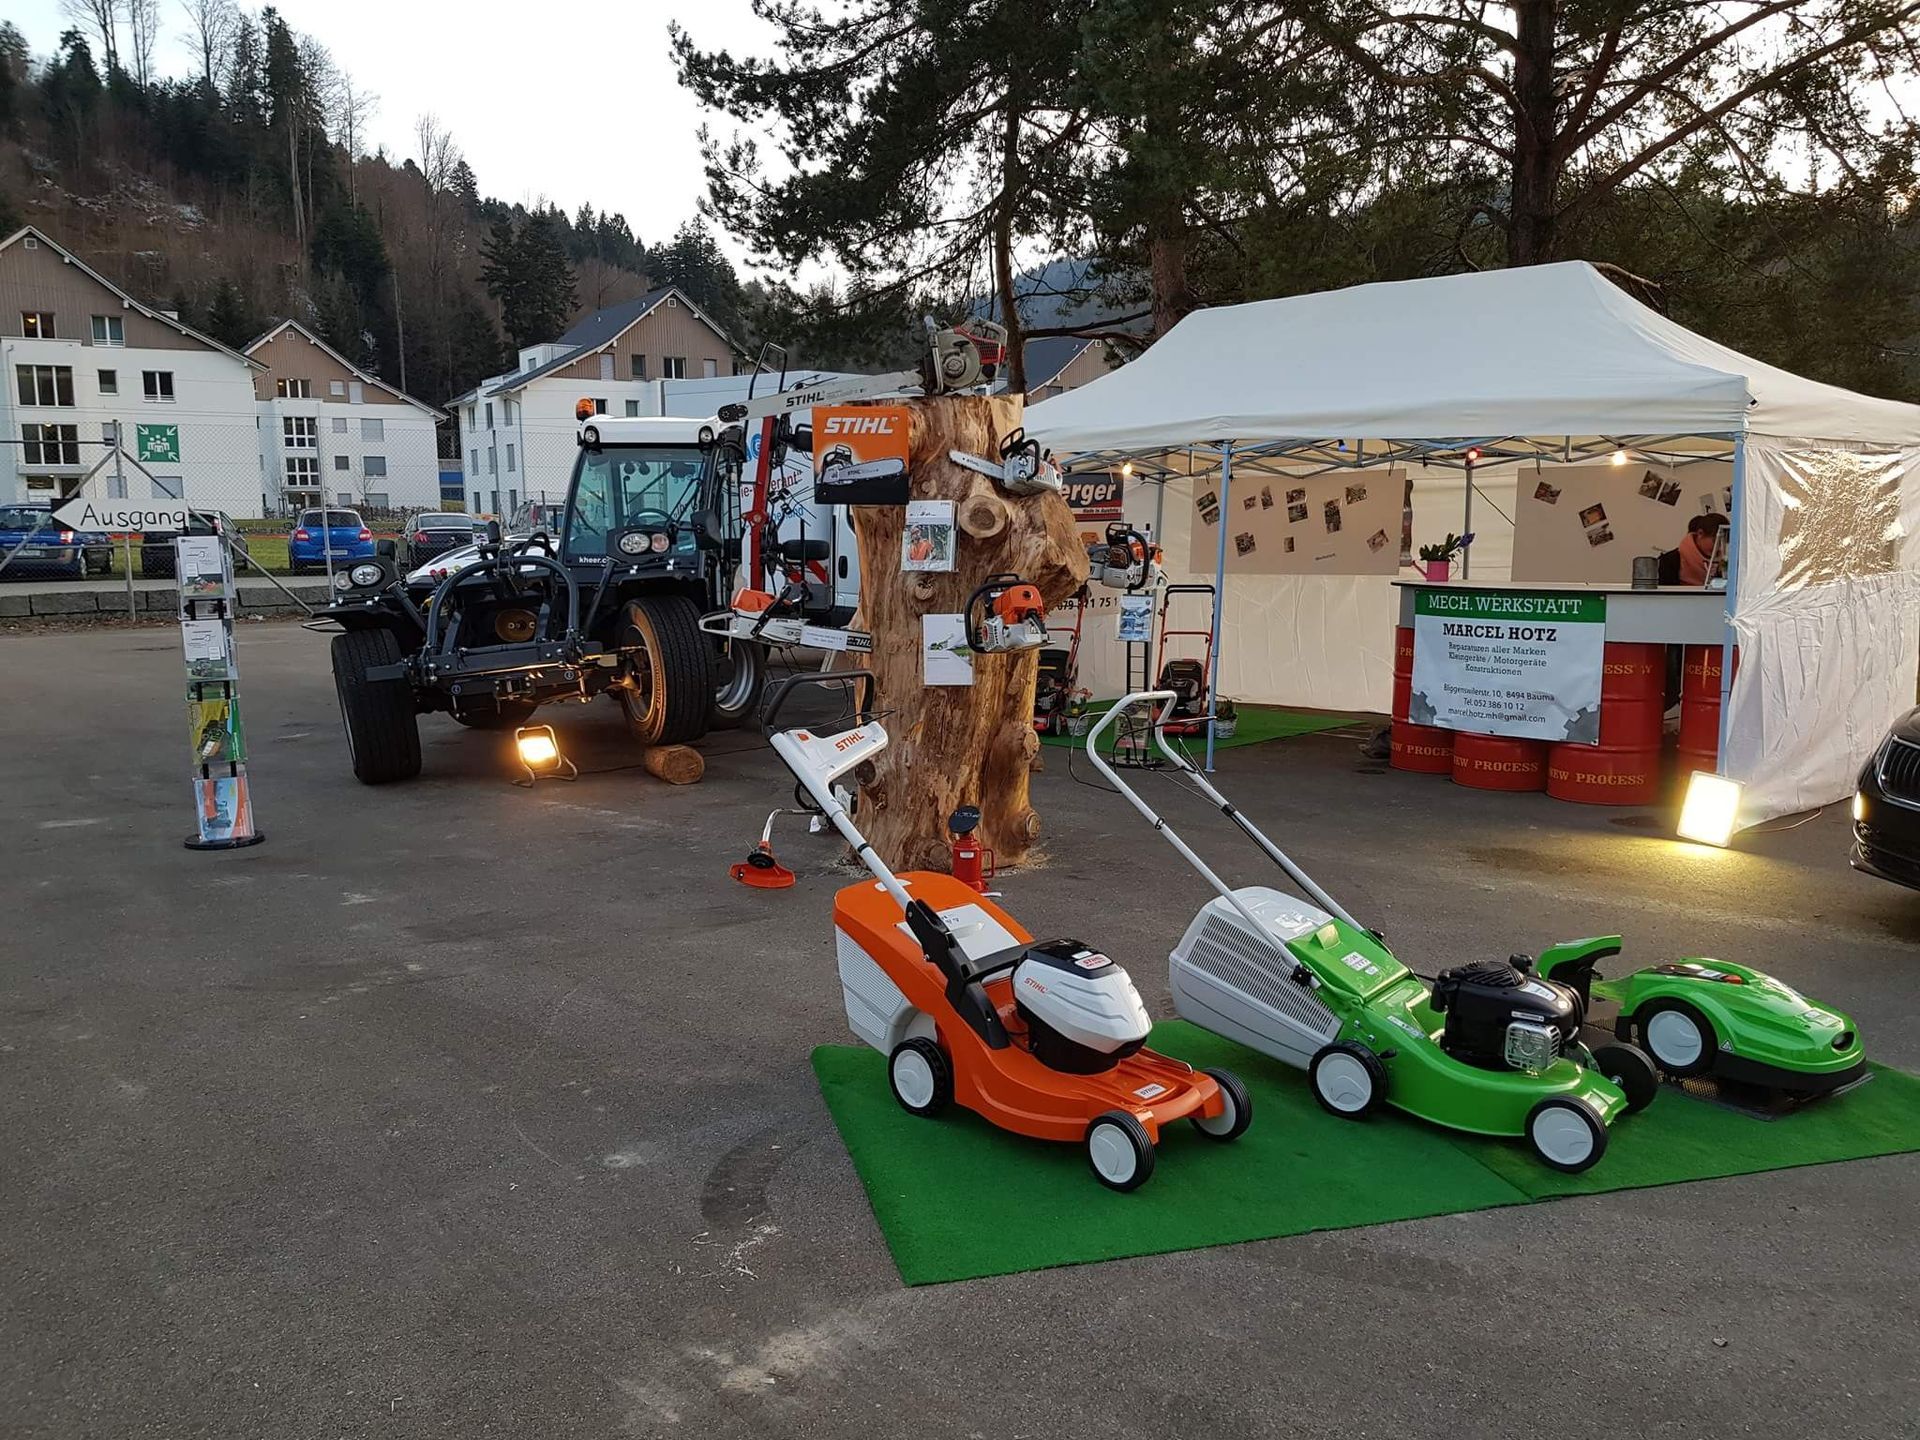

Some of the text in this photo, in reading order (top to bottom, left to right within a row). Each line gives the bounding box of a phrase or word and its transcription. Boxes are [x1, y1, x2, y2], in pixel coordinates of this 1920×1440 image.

[786, 392, 825, 407] STIHL
[824, 417, 894, 434] STIHL
[80, 503, 186, 531] Ausgang
[1100, 597, 1111, 607] 75
[1429, 595, 1582, 614] MECH. WERKSTATT
[1443, 623, 1557, 642] MARCEL HOTZ
[1448, 642, 1546, 656] Reparaturen aller Marken
[1448, 652, 1486, 663] Kleingeräte
[1494, 656, 1547, 667] Motorgeräte
[1465, 664, 1522, 676] Konstruktionen
[1492, 689, 1503, 699] 10,
[1506, 690, 1525, 700] 8494
[1527, 692, 1555, 702] Bauma
[1474, 699, 1488, 708] 052
[1488, 700, 1502, 709] 386
[1504, 702, 1514, 710] 10
[1516, 703, 1525, 711] 12
[1448, 707, 1546, 723] marcel.hotz.mh@gmail.com
[835, 730, 865, 752] STIHL
[1474, 760, 1539, 772] PROCESS
[1576, 773, 1645, 785] PROCESS
[1023, 977, 1048, 994] STIHL
